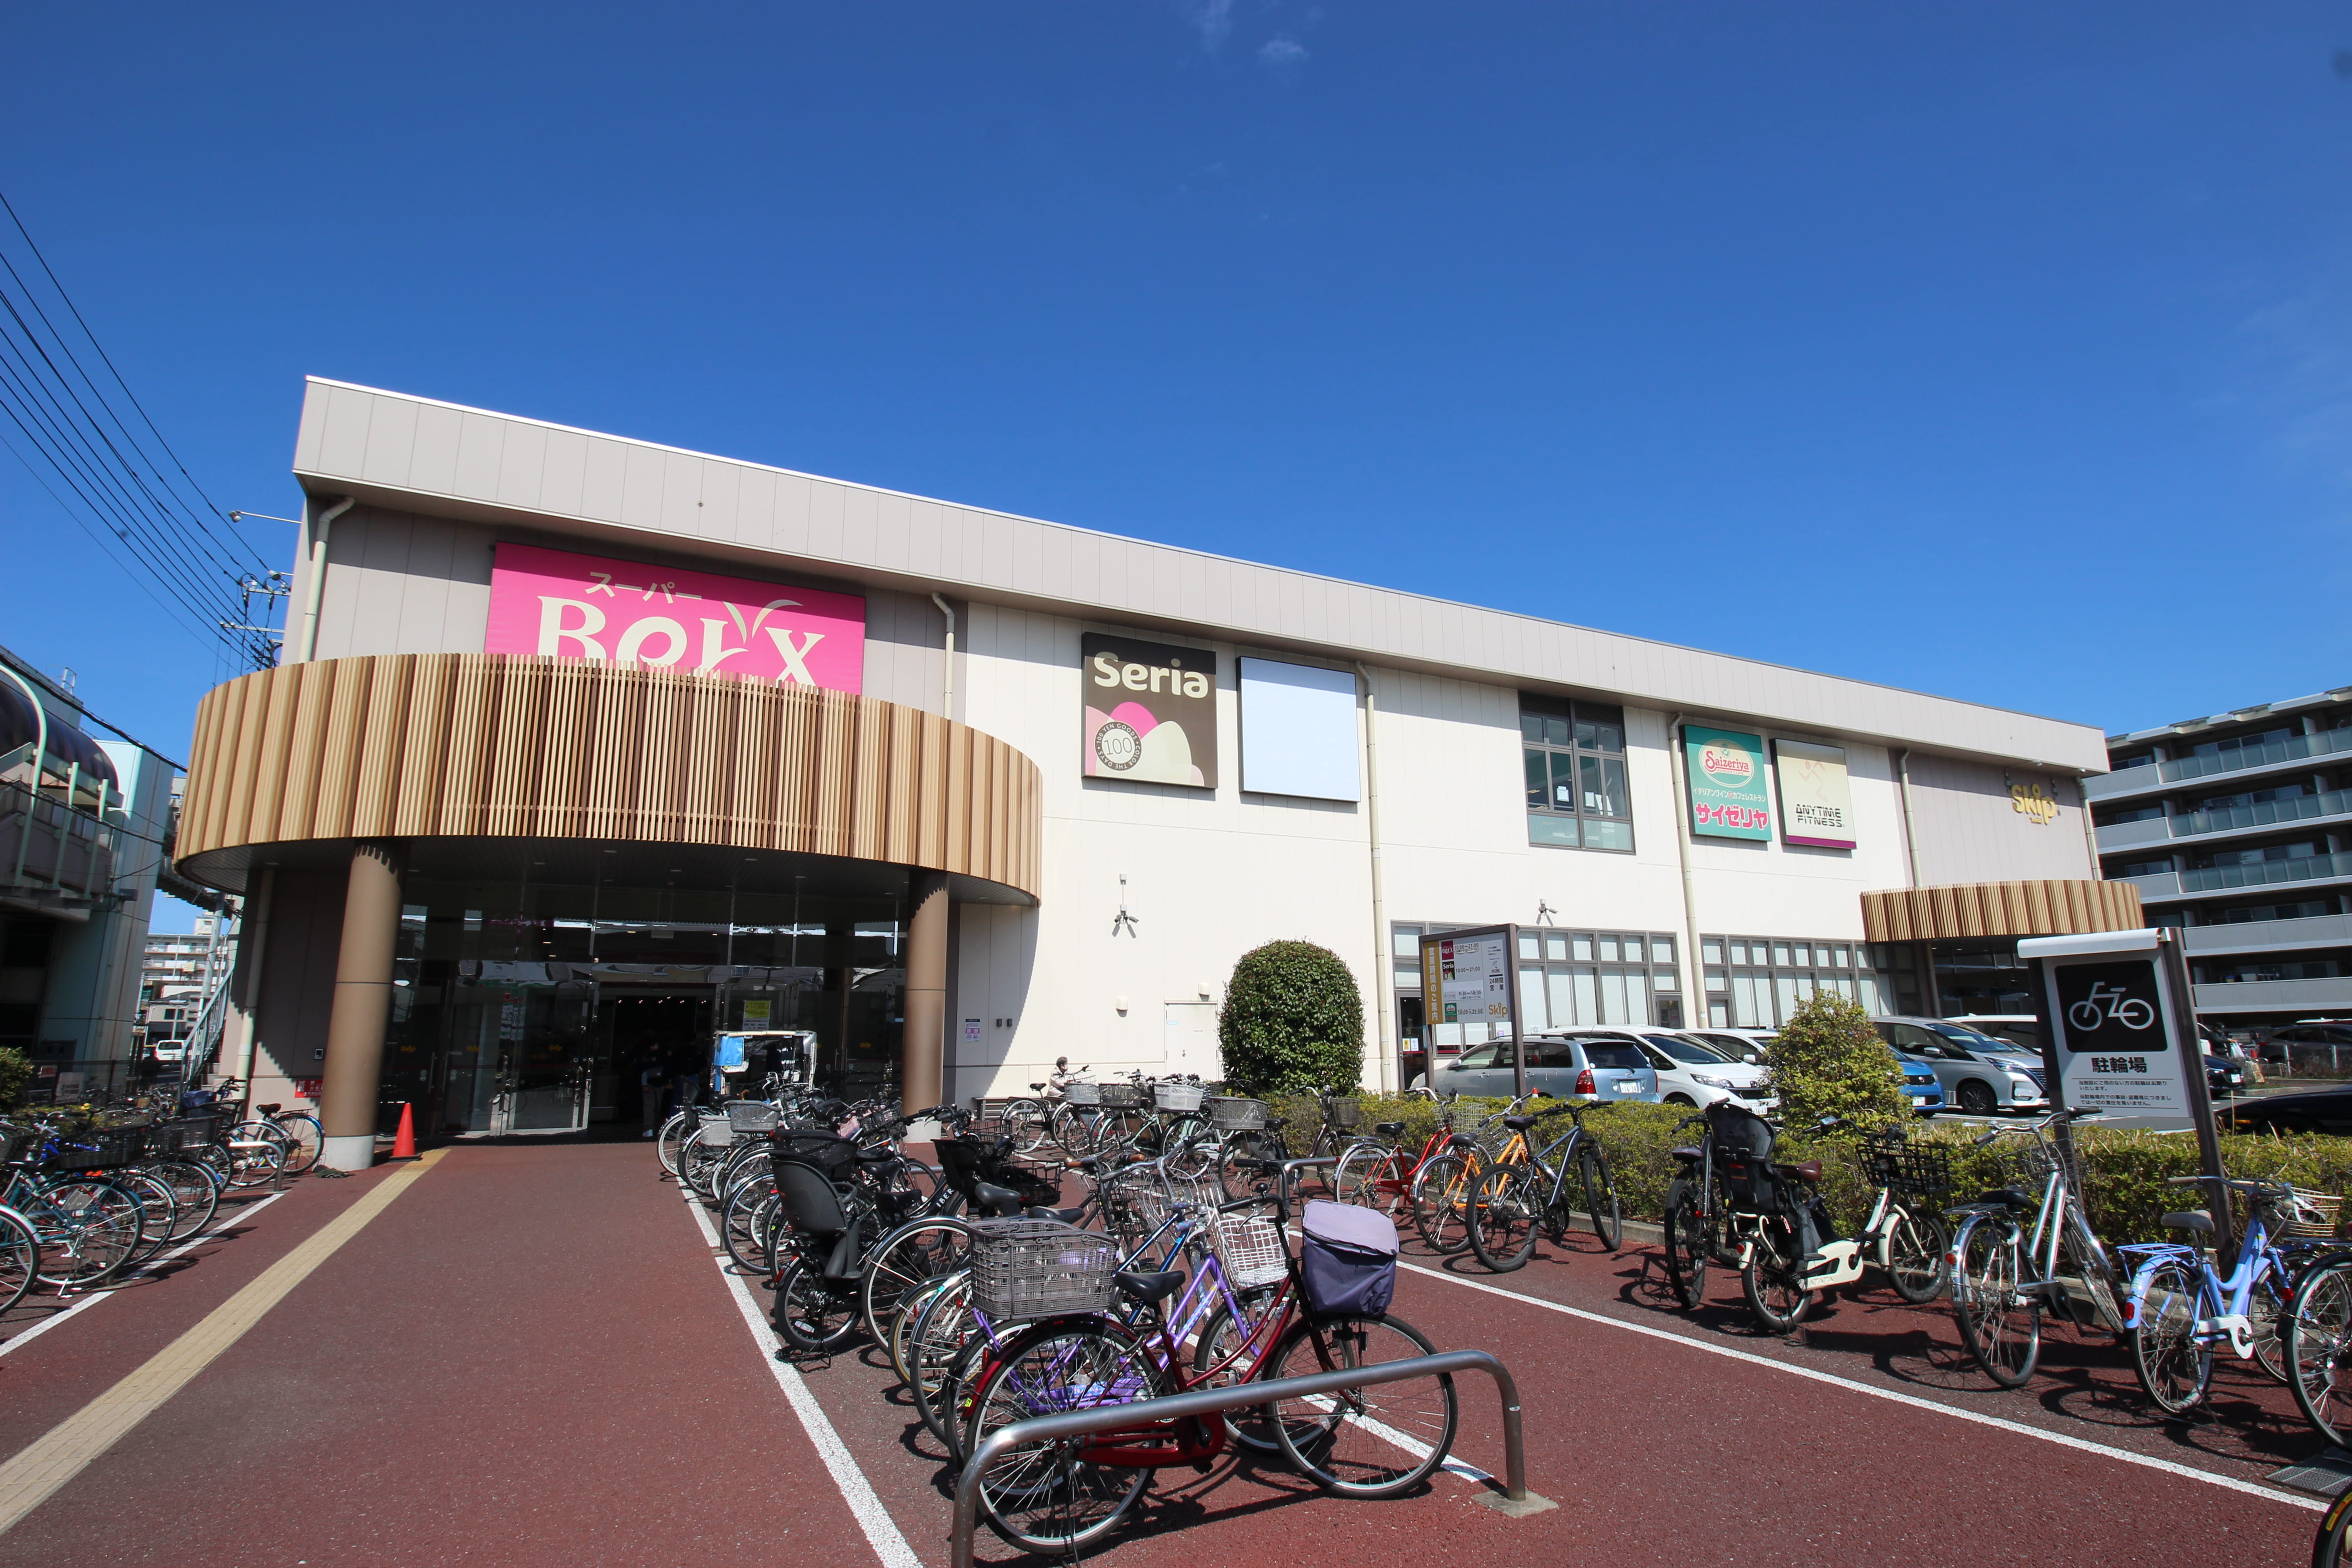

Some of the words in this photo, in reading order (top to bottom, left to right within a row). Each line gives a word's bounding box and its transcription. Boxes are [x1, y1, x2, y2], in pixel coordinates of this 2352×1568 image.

[585, 571, 702, 604] スーパー
[1093, 651, 1209, 699] Seria
[1102, 723, 1114, 732] YEN
[1117, 723, 1138, 740] GOODS
[1104, 737, 1132, 755] 100
[1128, 745, 1140, 766] COLOR
[1098, 751, 1113, 767] DAYS
[1705, 750, 1749, 772] Saizeriya
[2011, 784, 2056, 825] Skip
[1695, 802, 1768, 830] サイゼリヤ
[1489, 1002, 1508, 1018] Skip
[2091, 1057, 2147, 1073] 駐輪場
